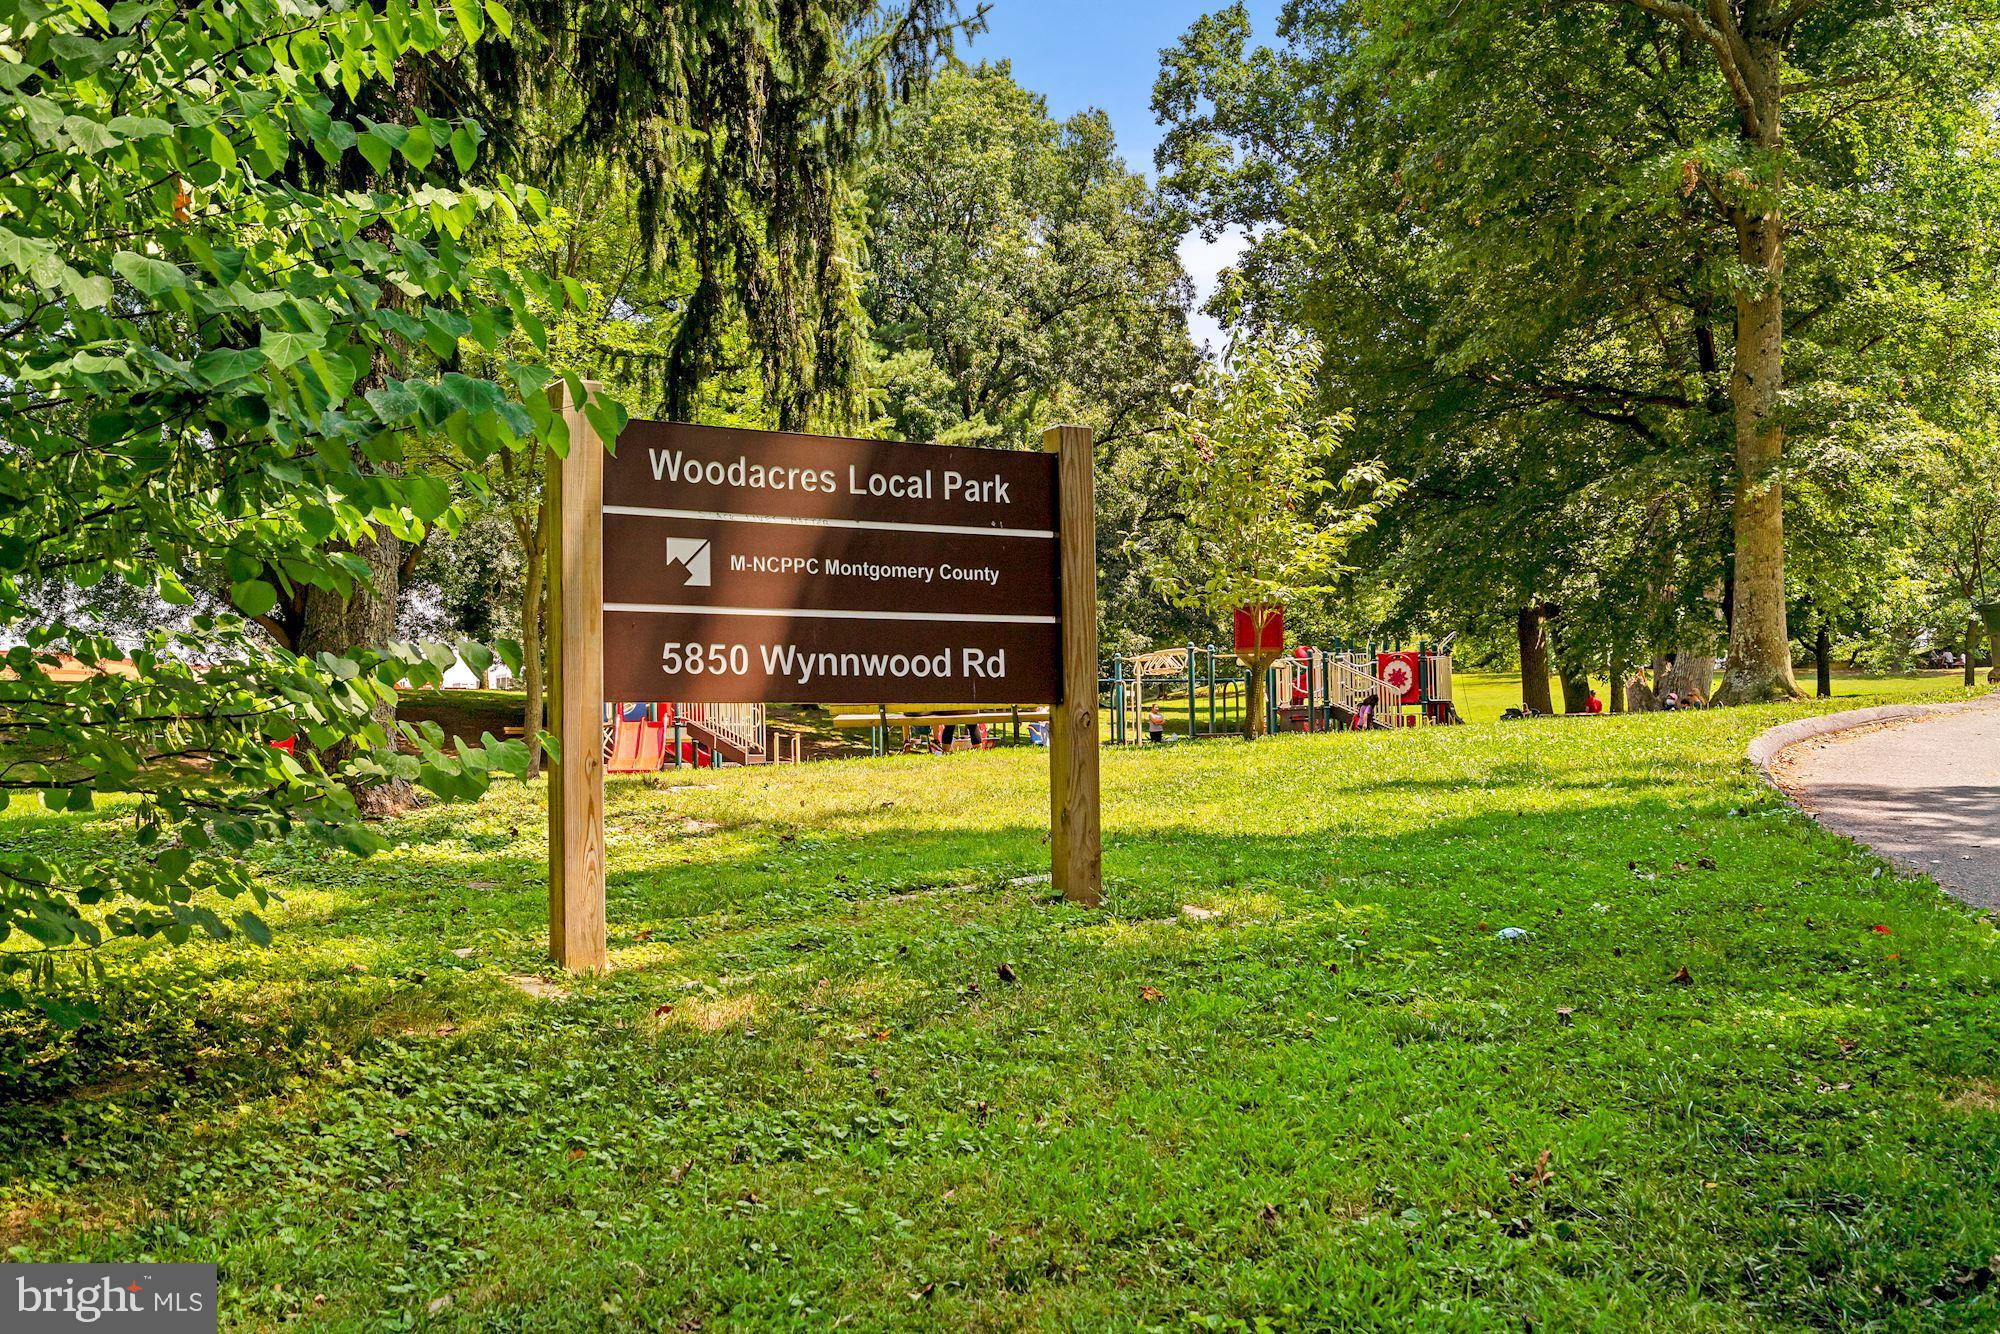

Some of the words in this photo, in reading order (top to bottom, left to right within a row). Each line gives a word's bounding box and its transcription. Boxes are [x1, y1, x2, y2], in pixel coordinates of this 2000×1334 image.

[649, 448, 837, 493] Woodacres
[850, 464, 932, 499] Local
[944, 471, 1011, 504] Park
[730, 555, 819, 574] M-NCPPC
[825, 559, 934, 583] Montgomery
[939, 563, 1000, 586] County
[661, 642, 749, 675] 5850
[760, 644, 951, 684] Wynnwood
[962, 648, 1006, 678] Rd
